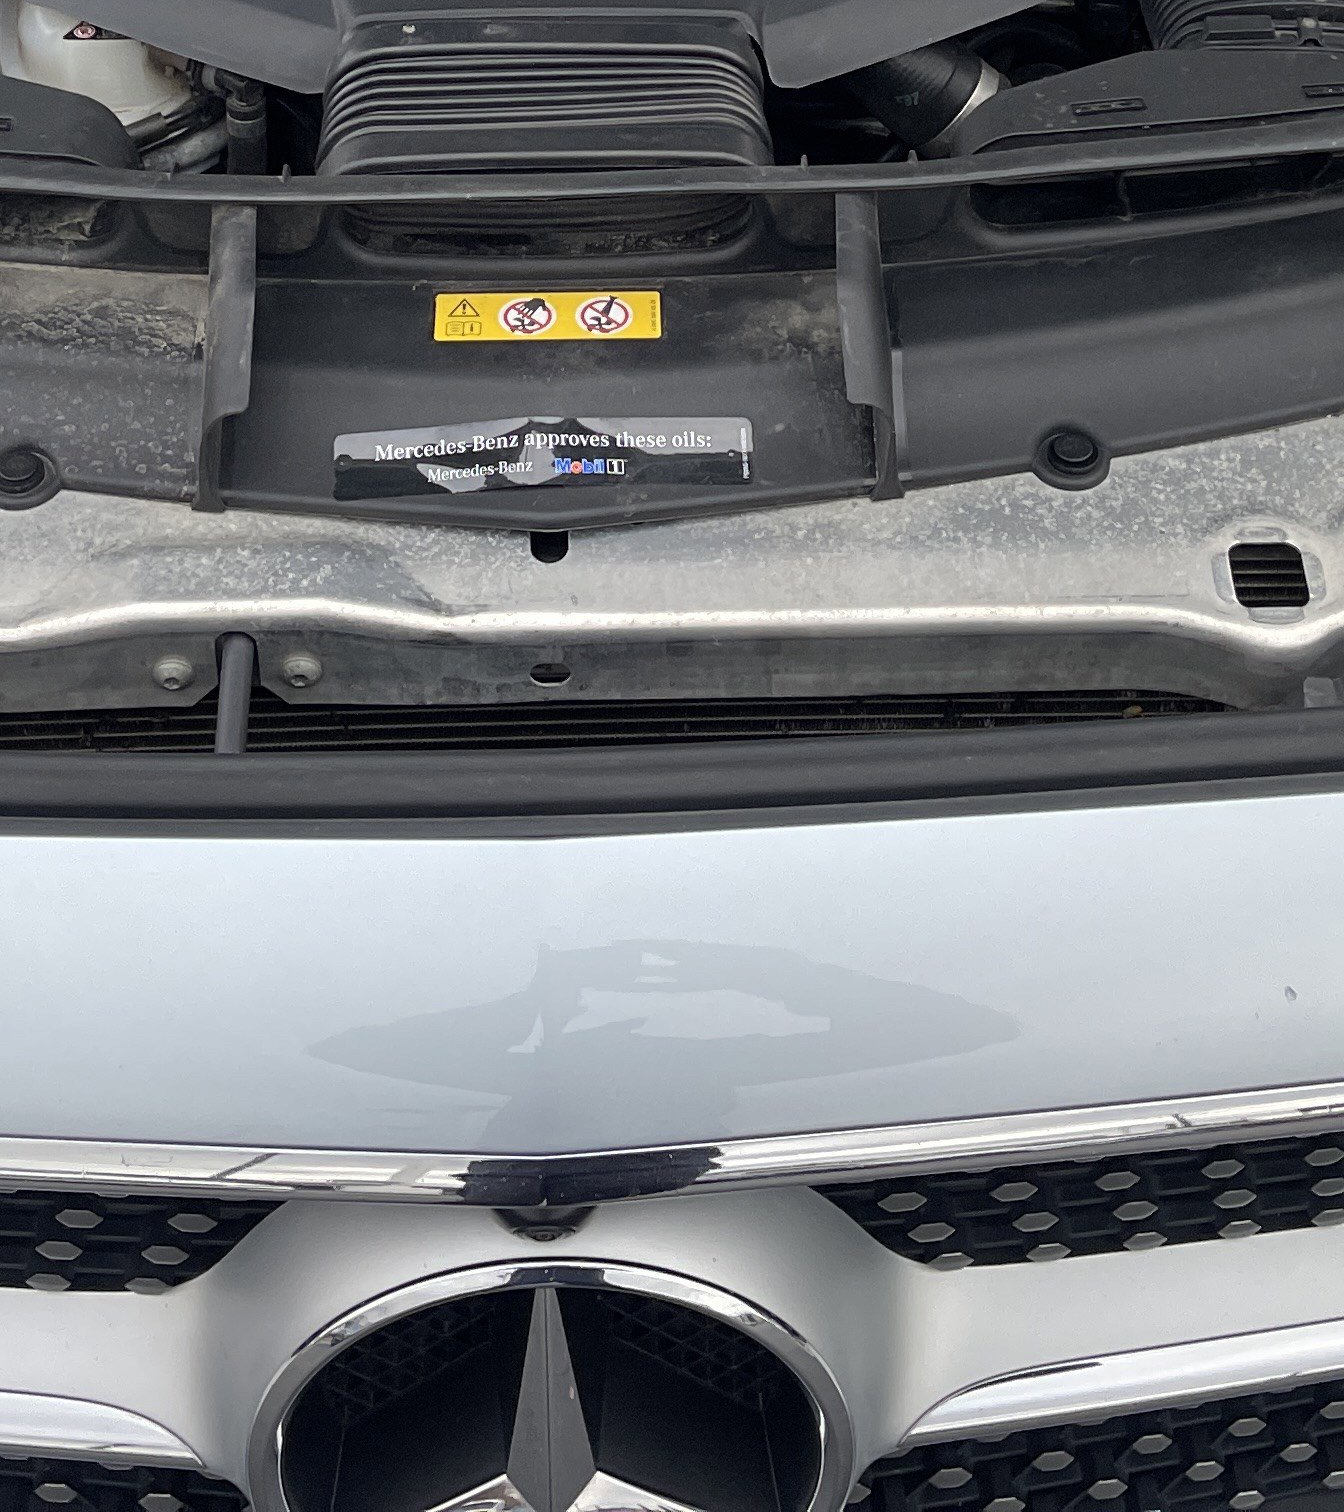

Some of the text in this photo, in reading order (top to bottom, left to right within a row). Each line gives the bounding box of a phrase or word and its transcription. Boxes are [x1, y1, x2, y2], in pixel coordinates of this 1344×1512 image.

[374, 431, 712, 462] Mercedes-Benz approves these oils:
[427, 460, 534, 483] Mercedes-Benz
[554, 457, 606, 475] Mobil
